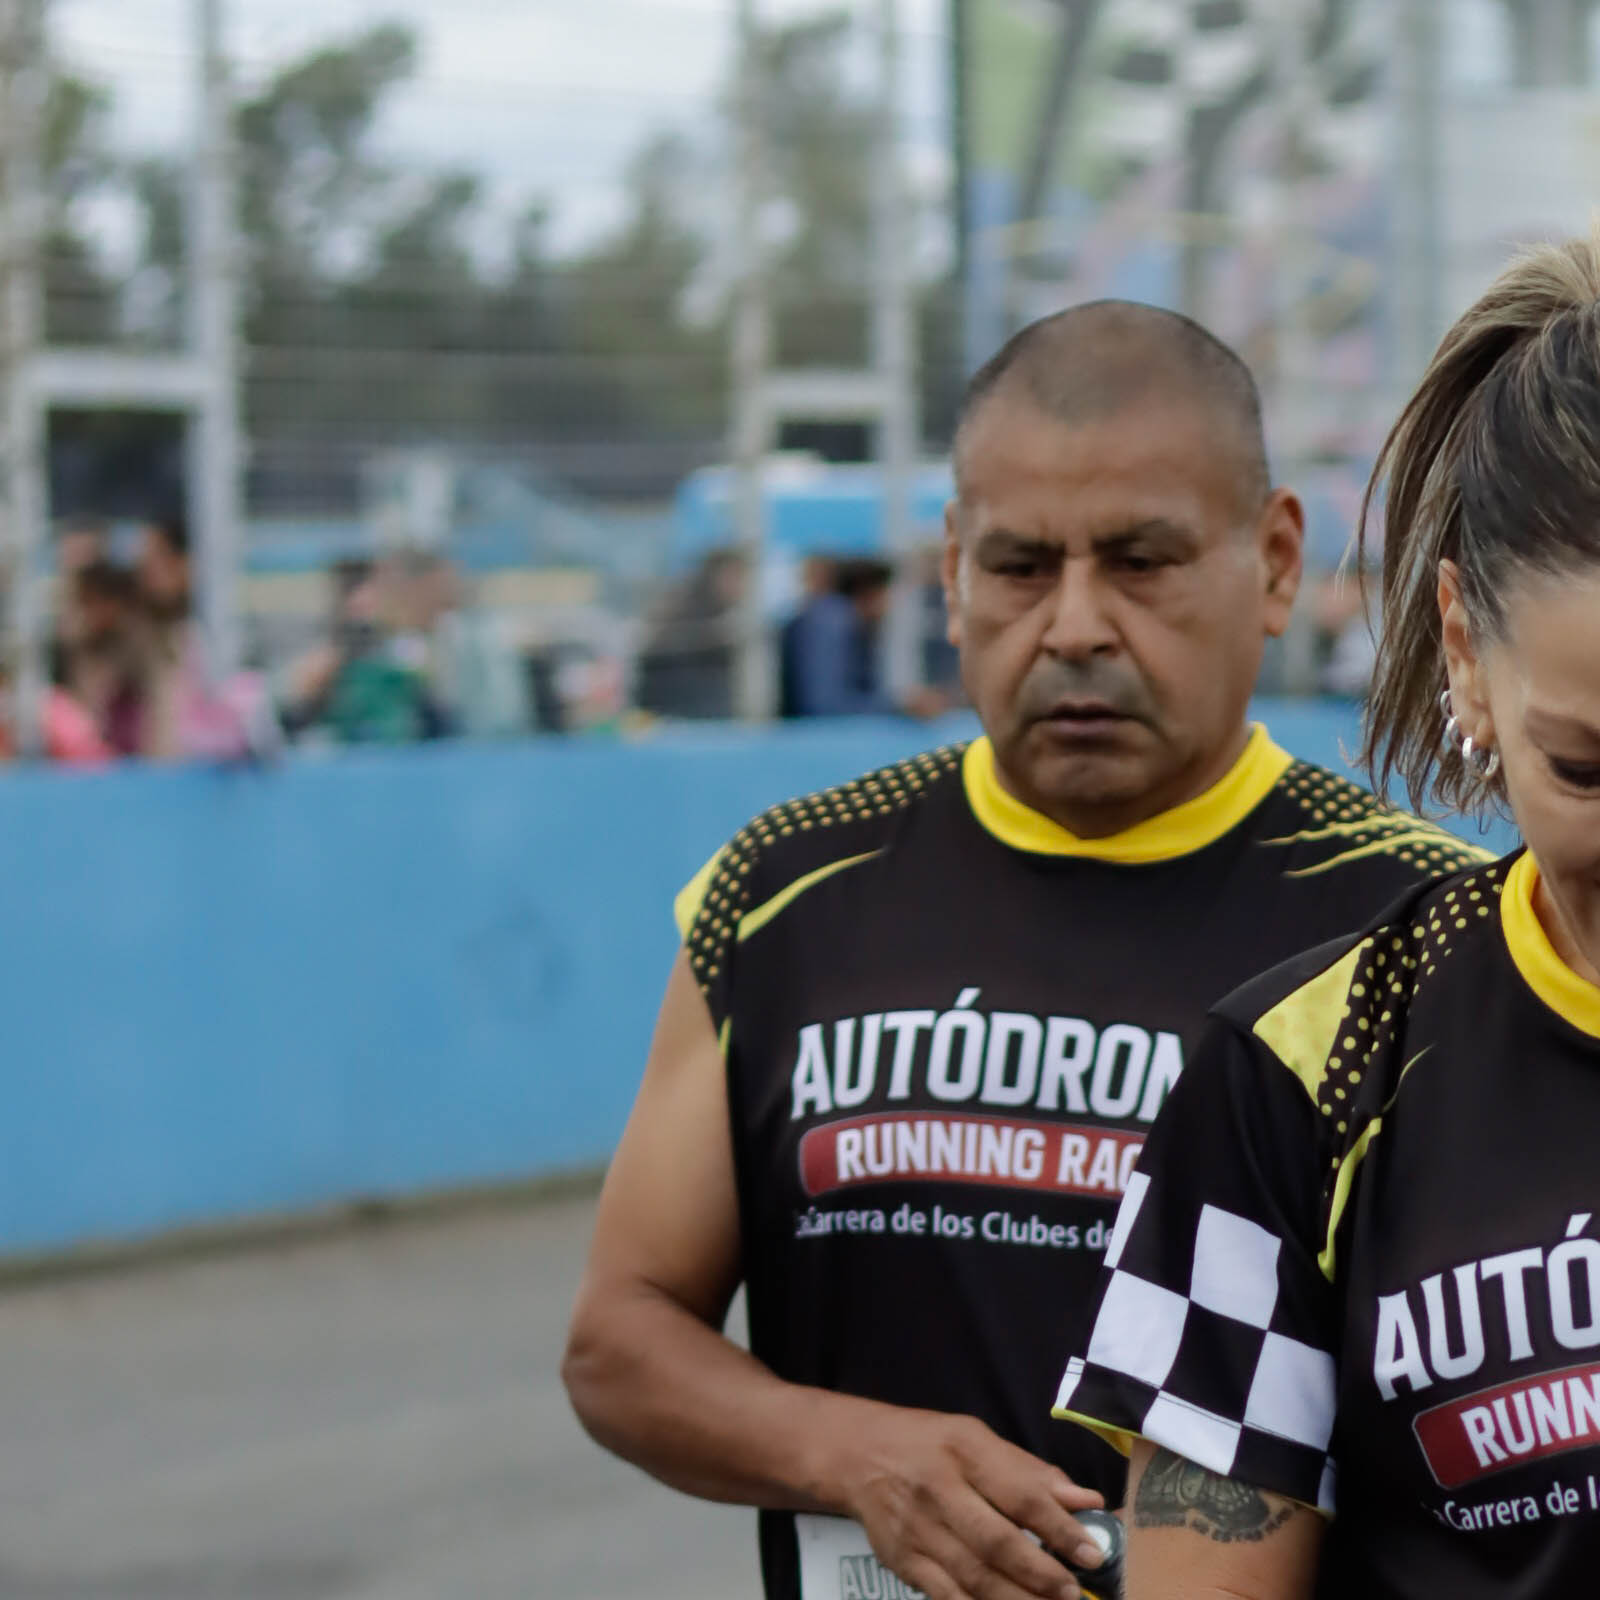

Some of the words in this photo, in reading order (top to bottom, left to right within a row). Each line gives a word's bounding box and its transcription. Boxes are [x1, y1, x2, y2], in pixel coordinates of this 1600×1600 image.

[836, 1119, 1047, 1182] RUNNING
[891, 1203, 926, 1234] de
[933, 1204, 974, 1238] los
[981, 1211, 1080, 1247] Clubes
[1444, 1496, 1541, 1531] Carrera
[1545, 1480, 1580, 1515] de
